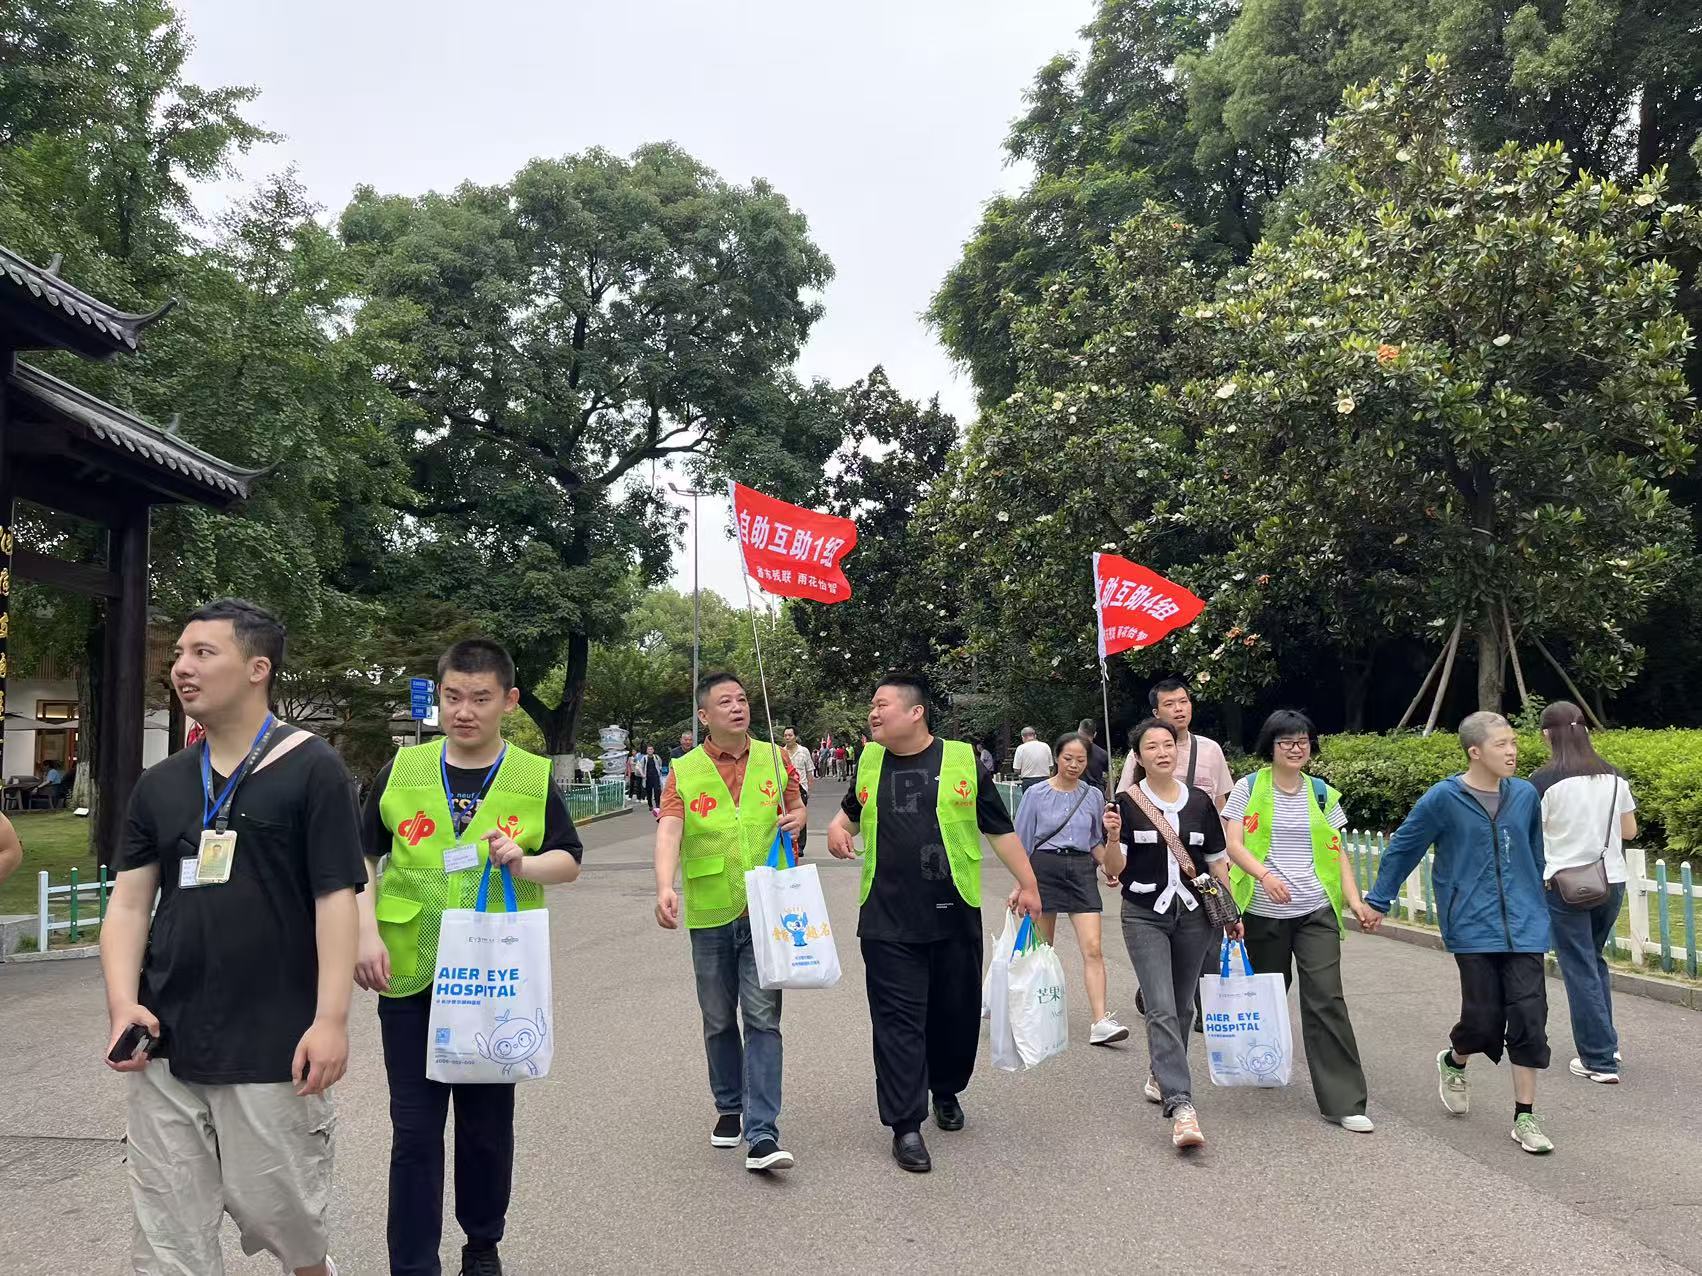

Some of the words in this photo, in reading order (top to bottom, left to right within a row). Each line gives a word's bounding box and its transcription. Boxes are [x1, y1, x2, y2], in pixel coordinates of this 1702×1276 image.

[438, 967, 480, 980] AIER
[487, 968, 520, 982] EYE
[436, 983, 516, 998] HOSPITAL
[1206, 1013, 1230, 1021] AIER
[1237, 1012, 1260, 1021] EYE
[1206, 1023, 1260, 1032] HOSPITAL
